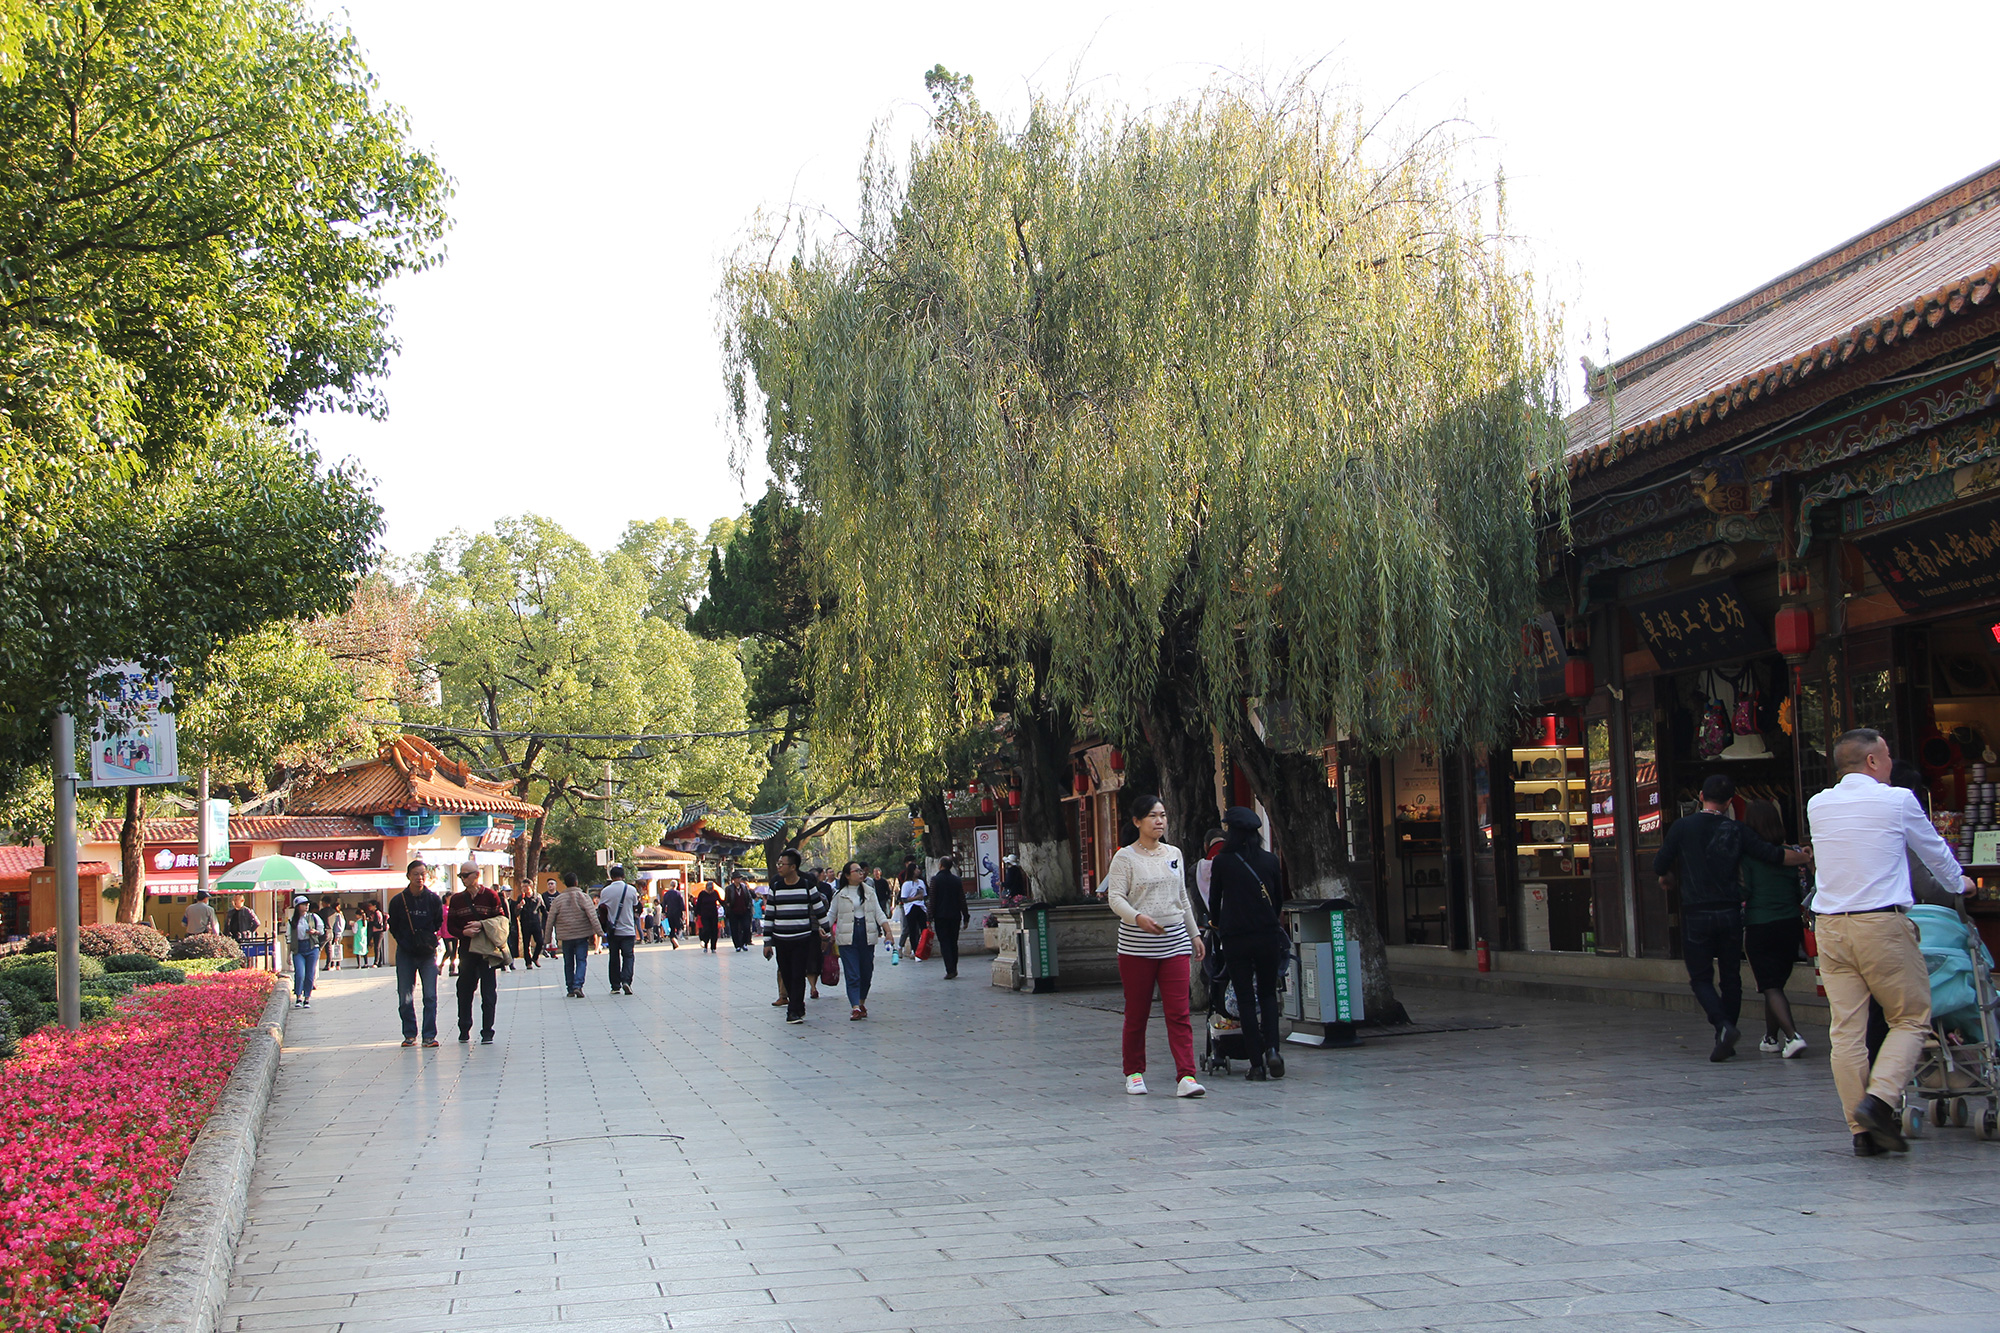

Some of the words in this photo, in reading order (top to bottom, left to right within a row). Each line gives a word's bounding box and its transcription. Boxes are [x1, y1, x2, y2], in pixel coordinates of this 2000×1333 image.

[1918, 586, 1950, 598] Yunnan
[1948, 579, 1971, 591] little
[1972, 573, 1994, 587] grain
[335, 849, 371, 861] 哈鲜族
[1332, 914, 1344, 951] 创建文明城市
[1337, 978, 1347, 996] 我参与
